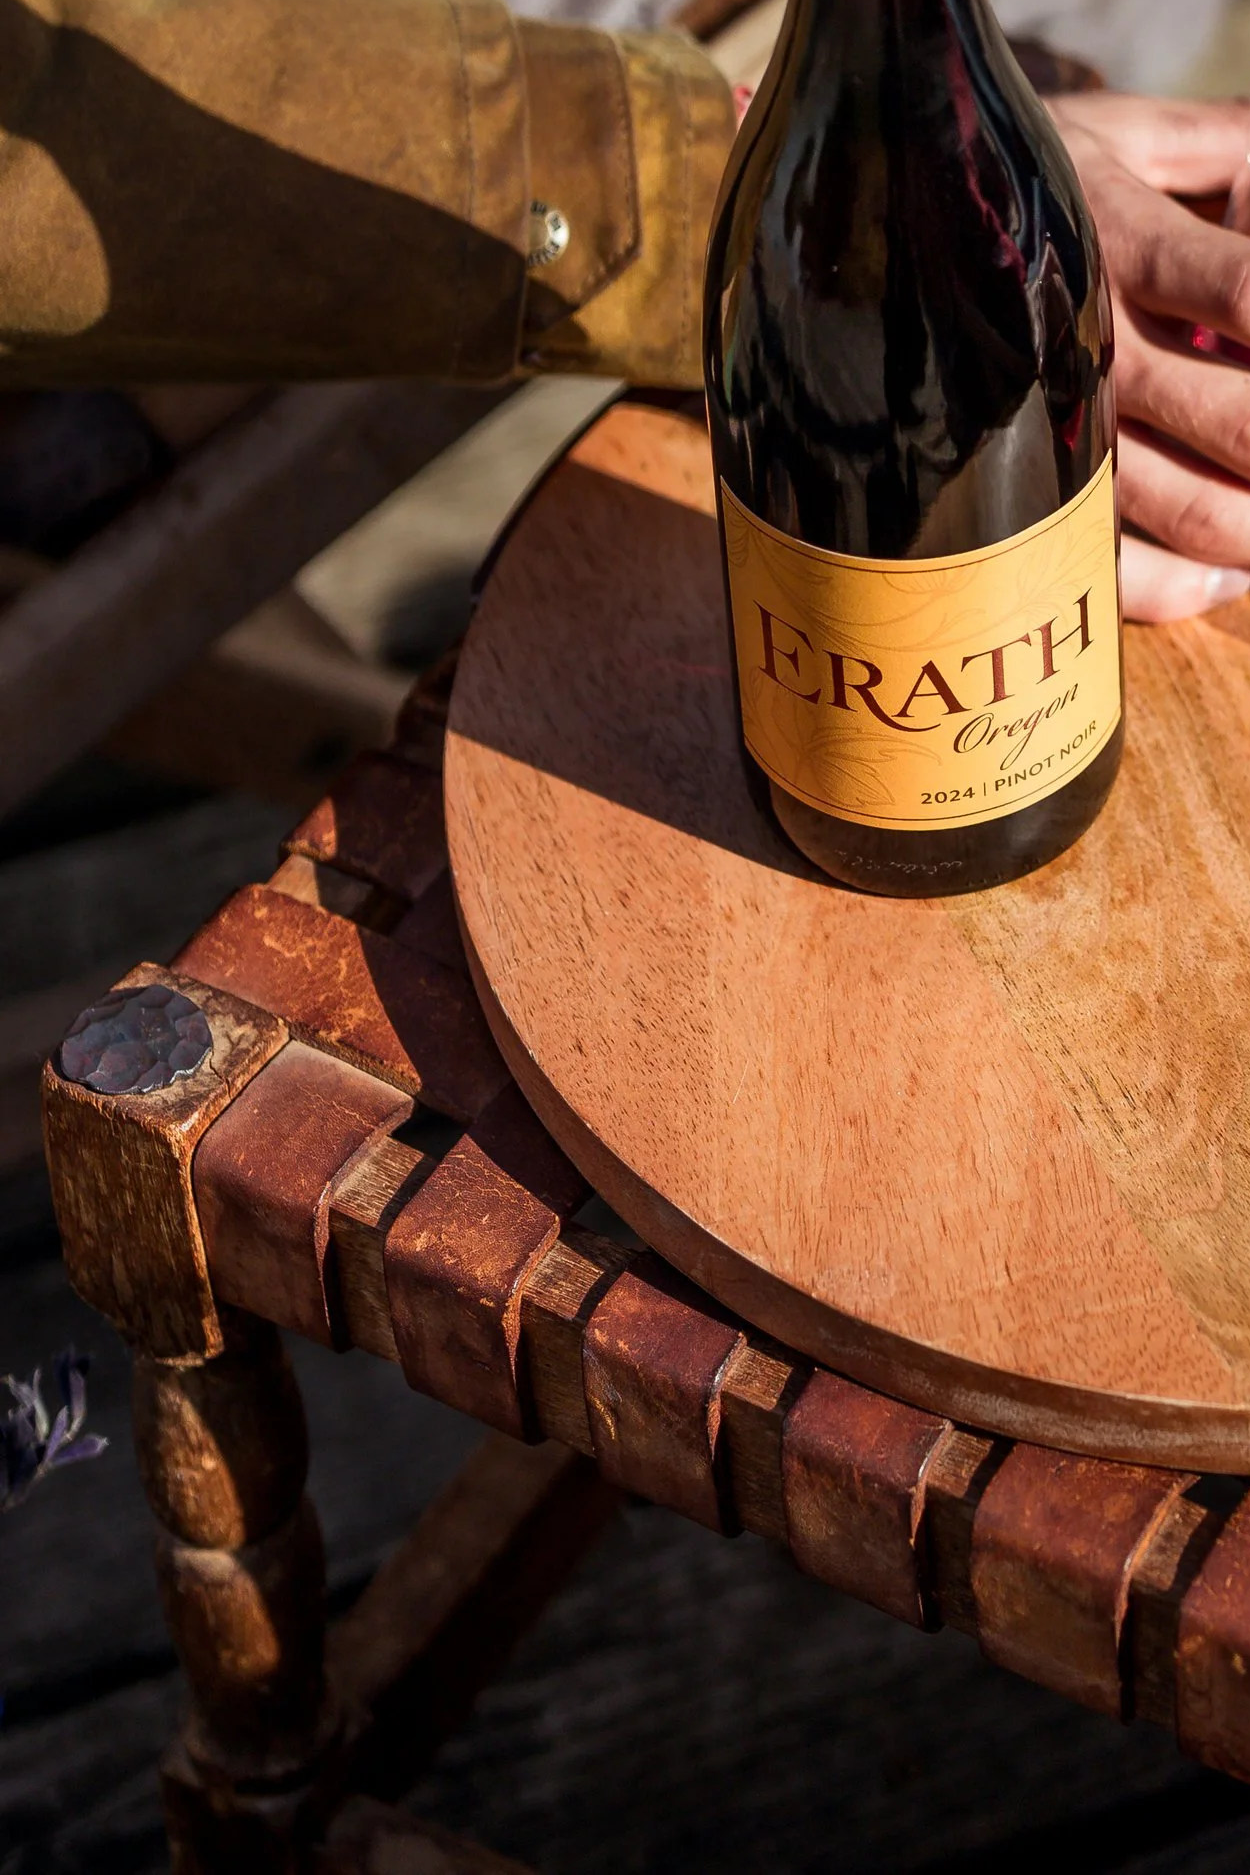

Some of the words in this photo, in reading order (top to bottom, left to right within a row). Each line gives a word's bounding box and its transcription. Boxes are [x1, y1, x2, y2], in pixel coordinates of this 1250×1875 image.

[753, 585, 1095, 733] ERATH
[920, 787, 976, 805] 2024
[994, 754, 1055, 791] PINOT
[1059, 720, 1097, 760] NOIR
[953, 682, 1079, 771] Oregon
